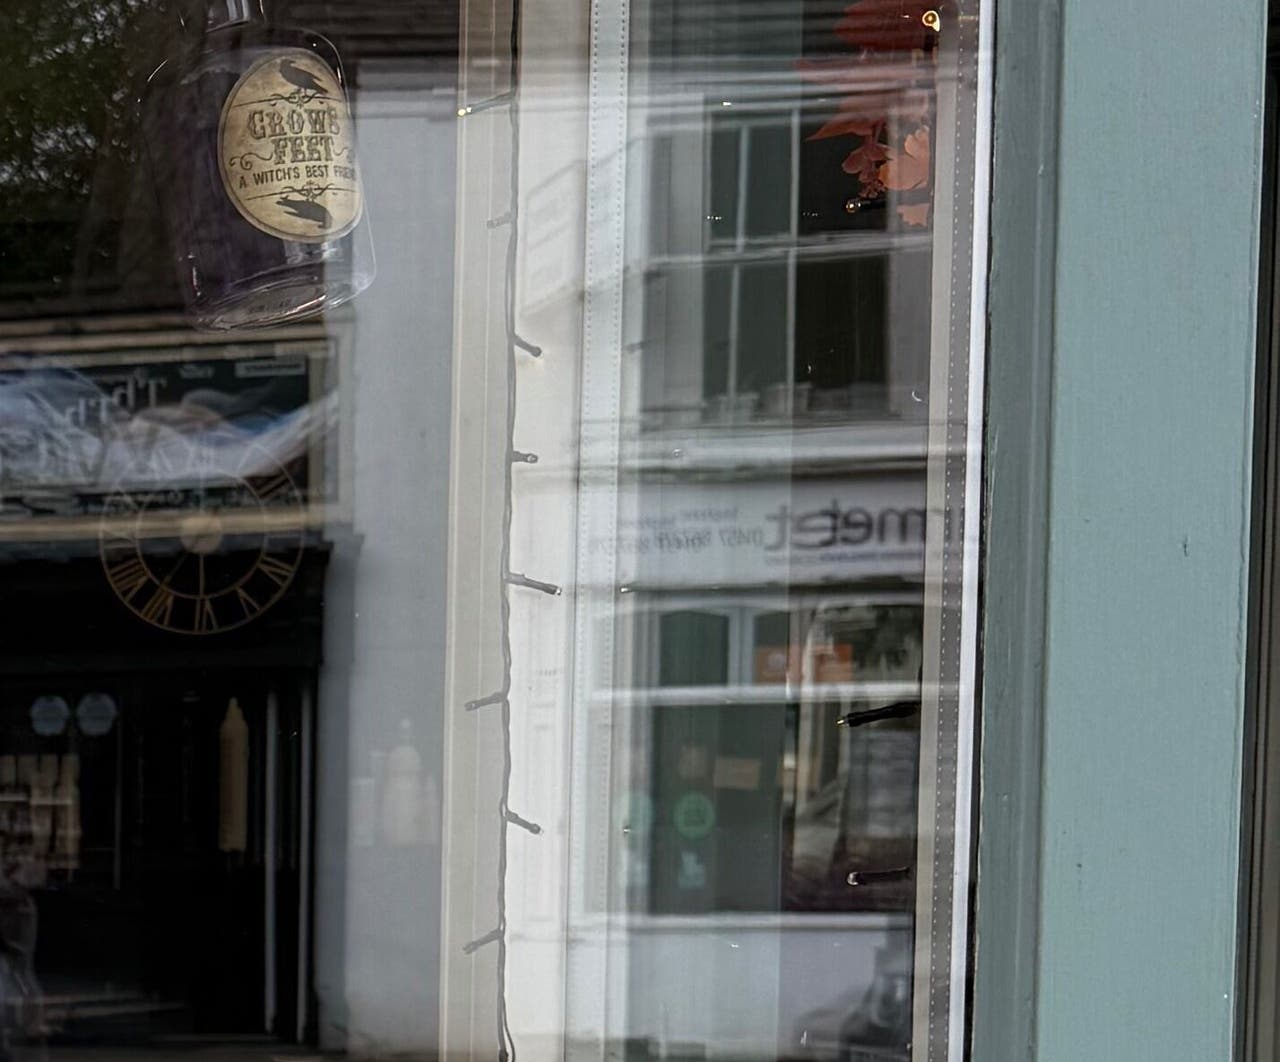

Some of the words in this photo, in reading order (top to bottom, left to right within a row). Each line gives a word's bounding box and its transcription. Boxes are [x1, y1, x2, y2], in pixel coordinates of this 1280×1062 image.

[272, 135, 335, 165] FEET
[239, 175, 248, 189] A
[253, 166, 300, 186] WITCH'S
[305, 164, 329, 178] BEST
